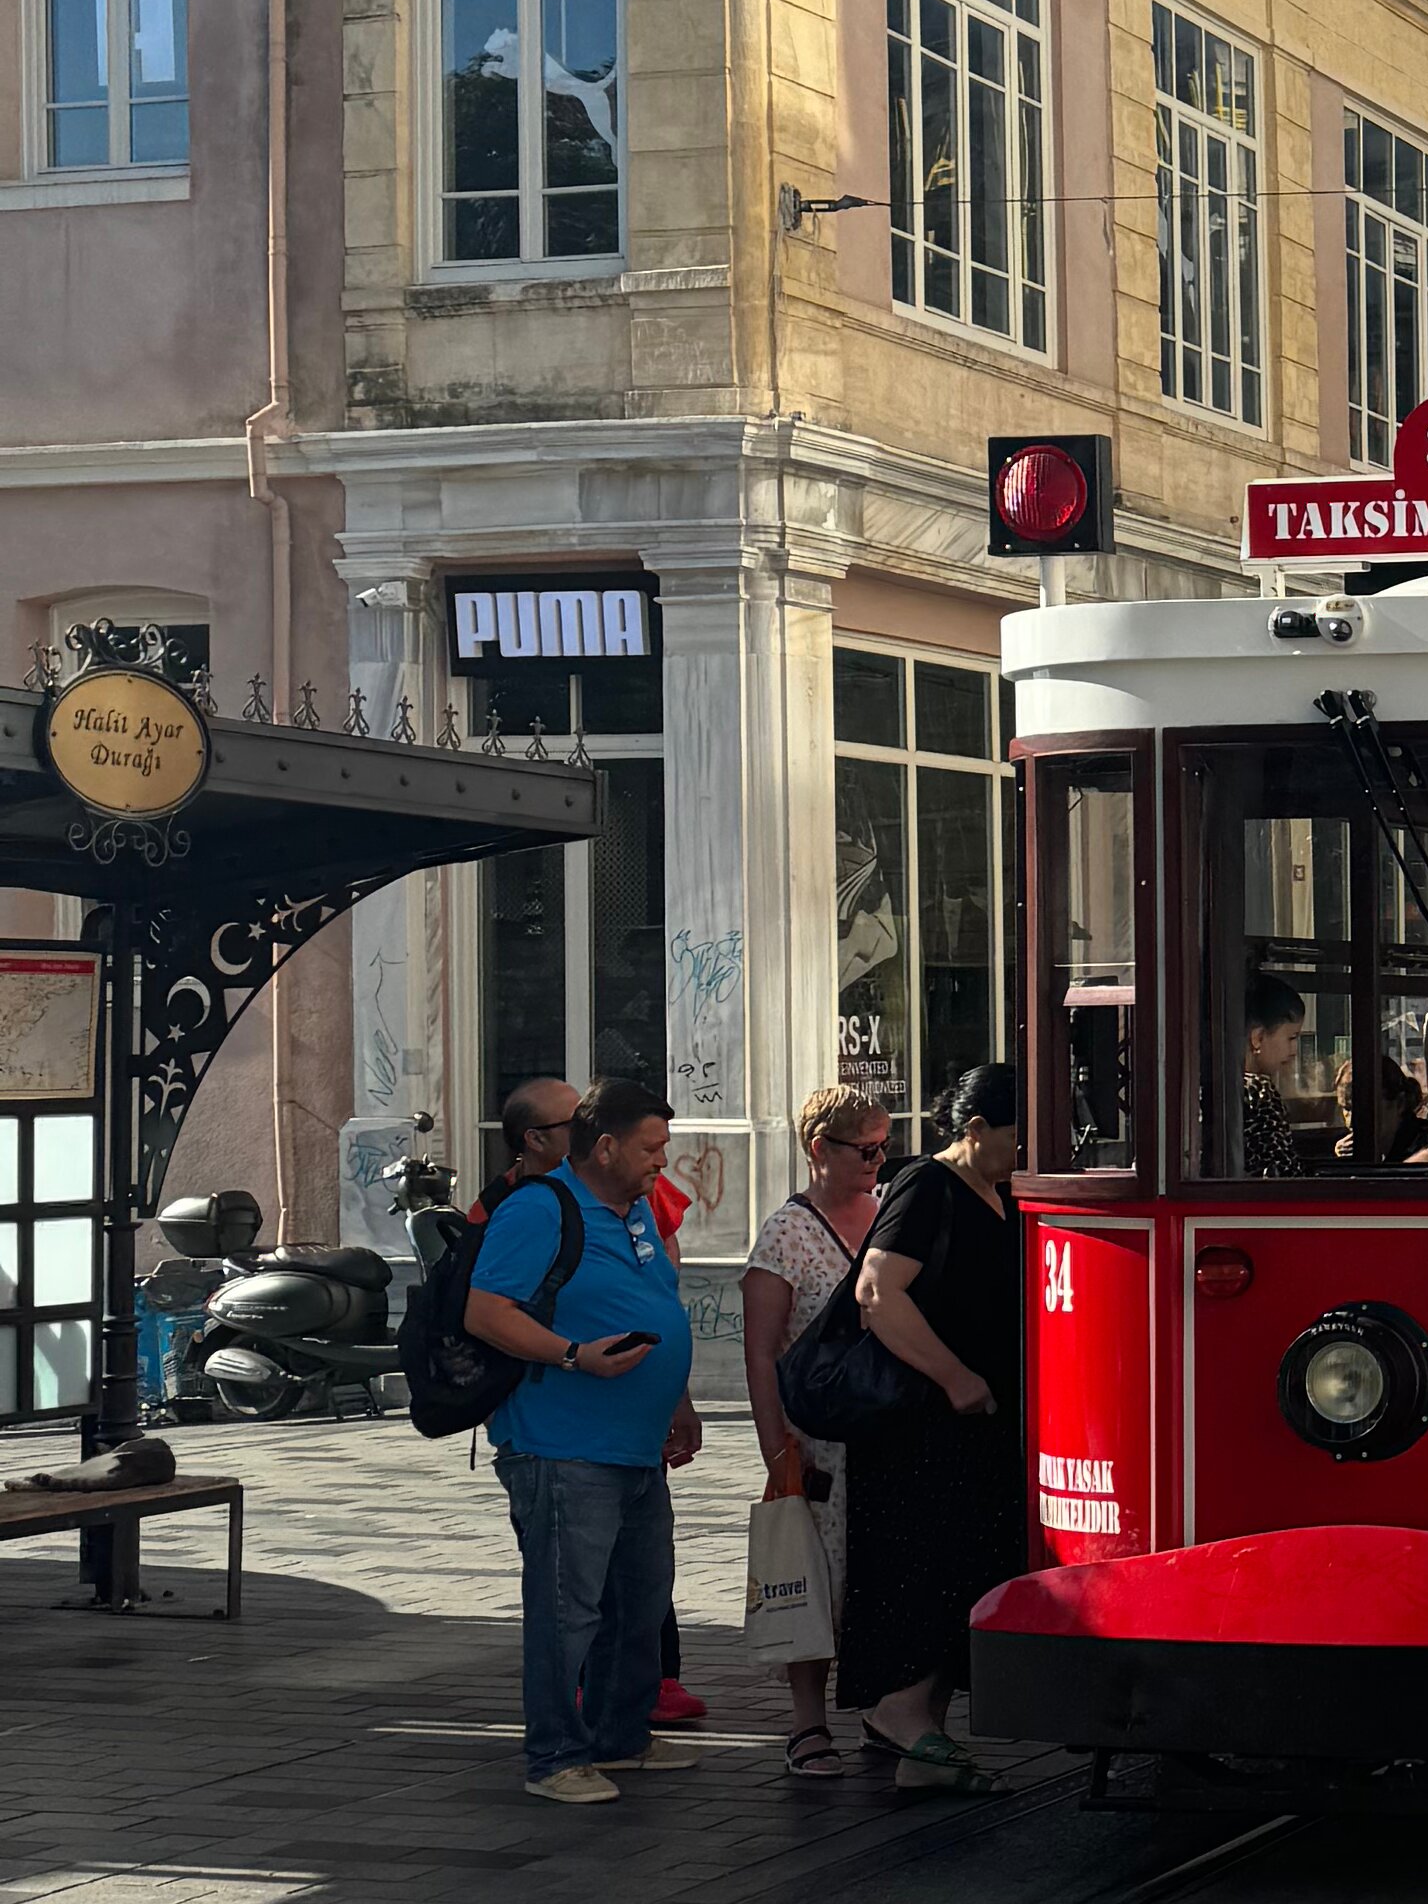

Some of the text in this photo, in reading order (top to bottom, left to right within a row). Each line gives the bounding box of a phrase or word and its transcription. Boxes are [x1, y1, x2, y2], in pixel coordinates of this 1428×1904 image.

[455, 590, 651, 658] PUMA
[73, 709, 184, 745] Halil Ayar
[90, 744, 161, 776] Durağı
[838, 1015, 881, 1055] RS-X
[1045, 1239, 1074, 1312] 34
[1066, 1457, 1114, 1493] YASAK
[764, 1576, 807, 1599] travel
